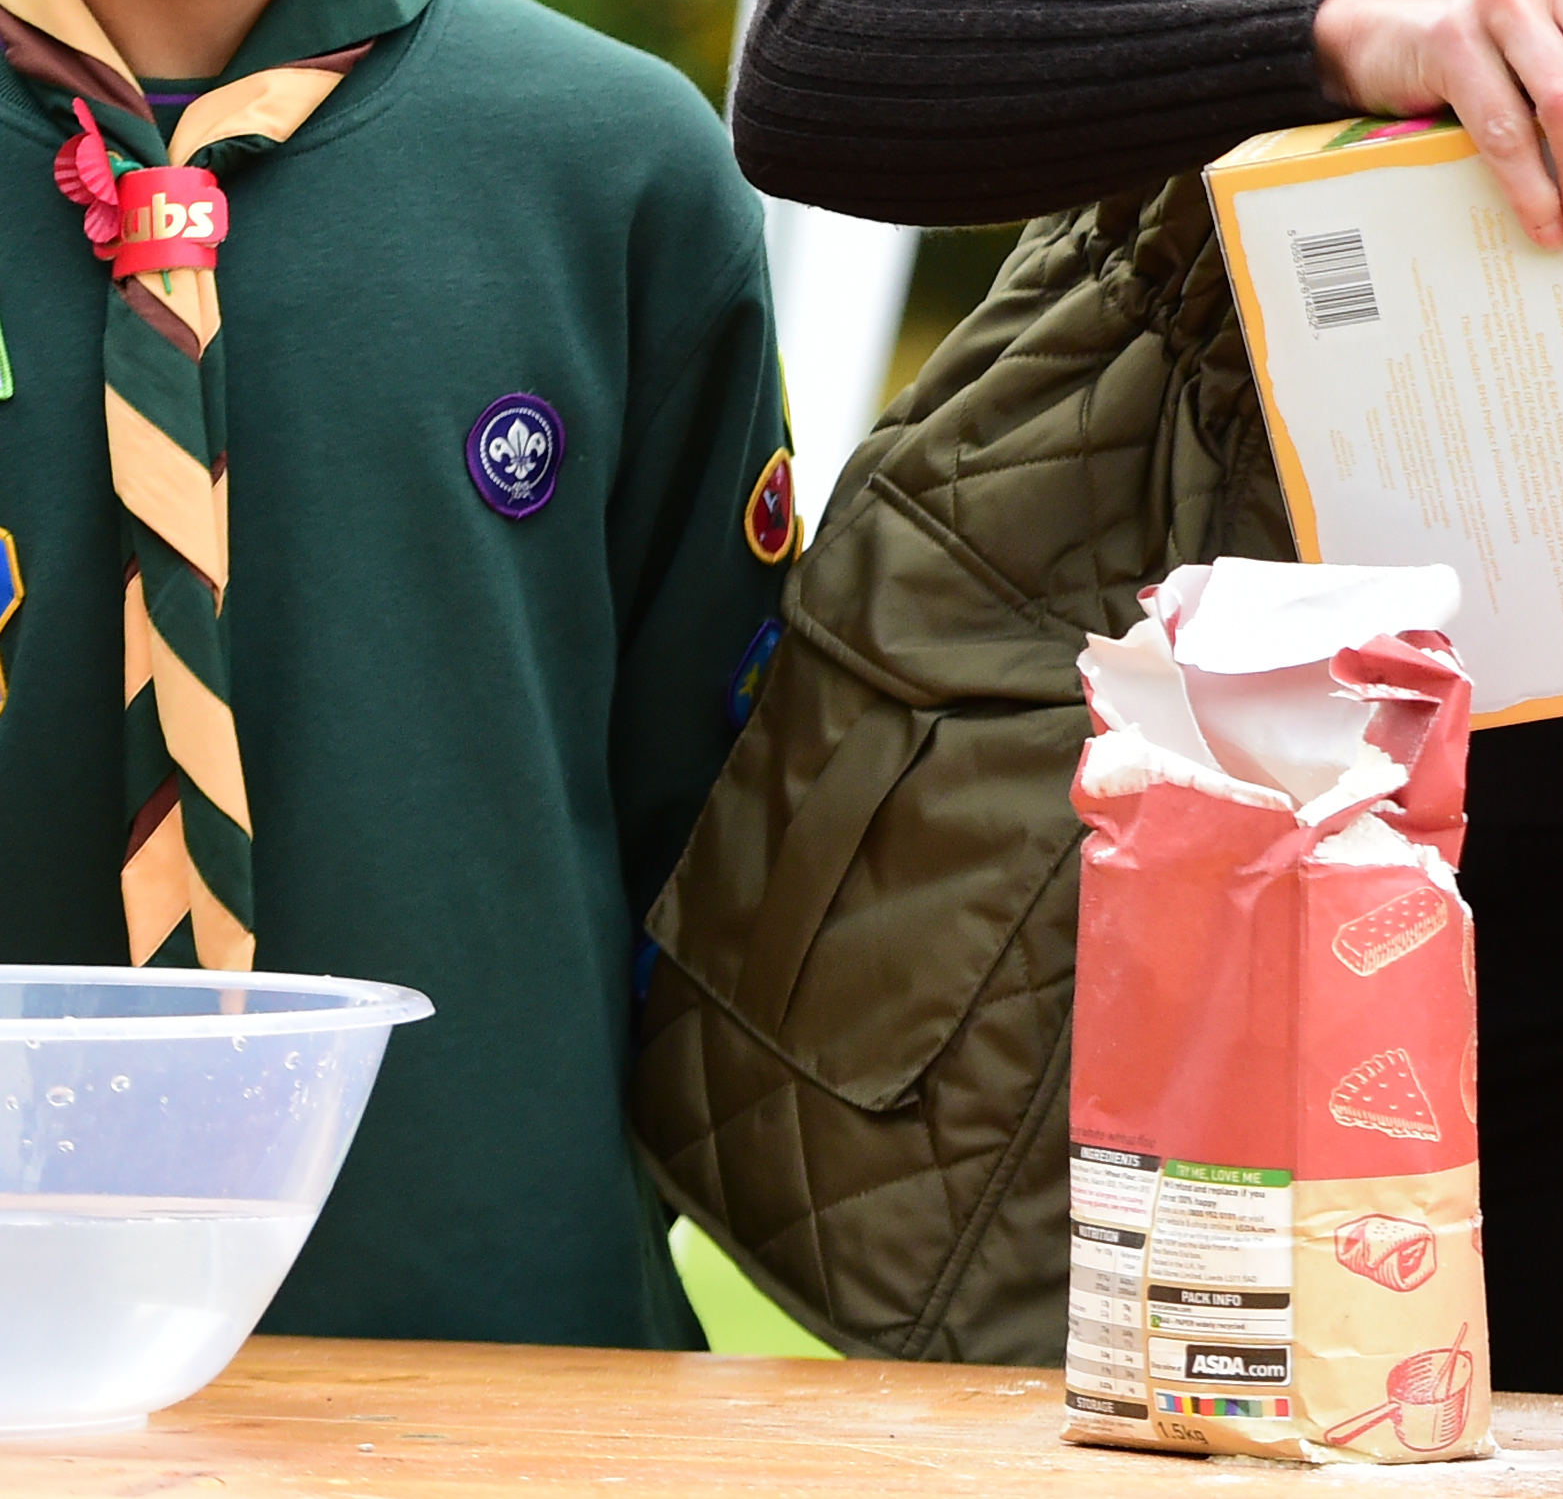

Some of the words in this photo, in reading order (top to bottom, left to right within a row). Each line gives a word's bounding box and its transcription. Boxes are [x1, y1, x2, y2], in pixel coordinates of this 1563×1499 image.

[123, 192, 215, 242] ubs
[1286, 229, 1296, 237] 5
[1289, 242, 1306, 283] 055128
[1299, 286, 1317, 327] 614252
[1081, 1146, 1142, 1168] INGREDIENTS
[1211, 1169, 1240, 1182] LOVE
[1242, 1172, 1262, 1184] ME
[1209, 1186, 1239, 1197] replace
[1241, 1188, 1247, 1197] if
[1249, 1190, 1266, 1200] you
[1079, 1225, 1120, 1243] NUTRITION
[1181, 1291, 1211, 1305] PACK
[1212, 1294, 1243, 1307] INFO
[1196, 1320, 1216, 1330] widely
[1217, 1322, 1245, 1331] recycled
[1191, 1354, 1286, 1377] ASDA.com
[1076, 1396, 1115, 1414] STORAGE
[1157, 1421, 1209, 1445] 1.5kg
